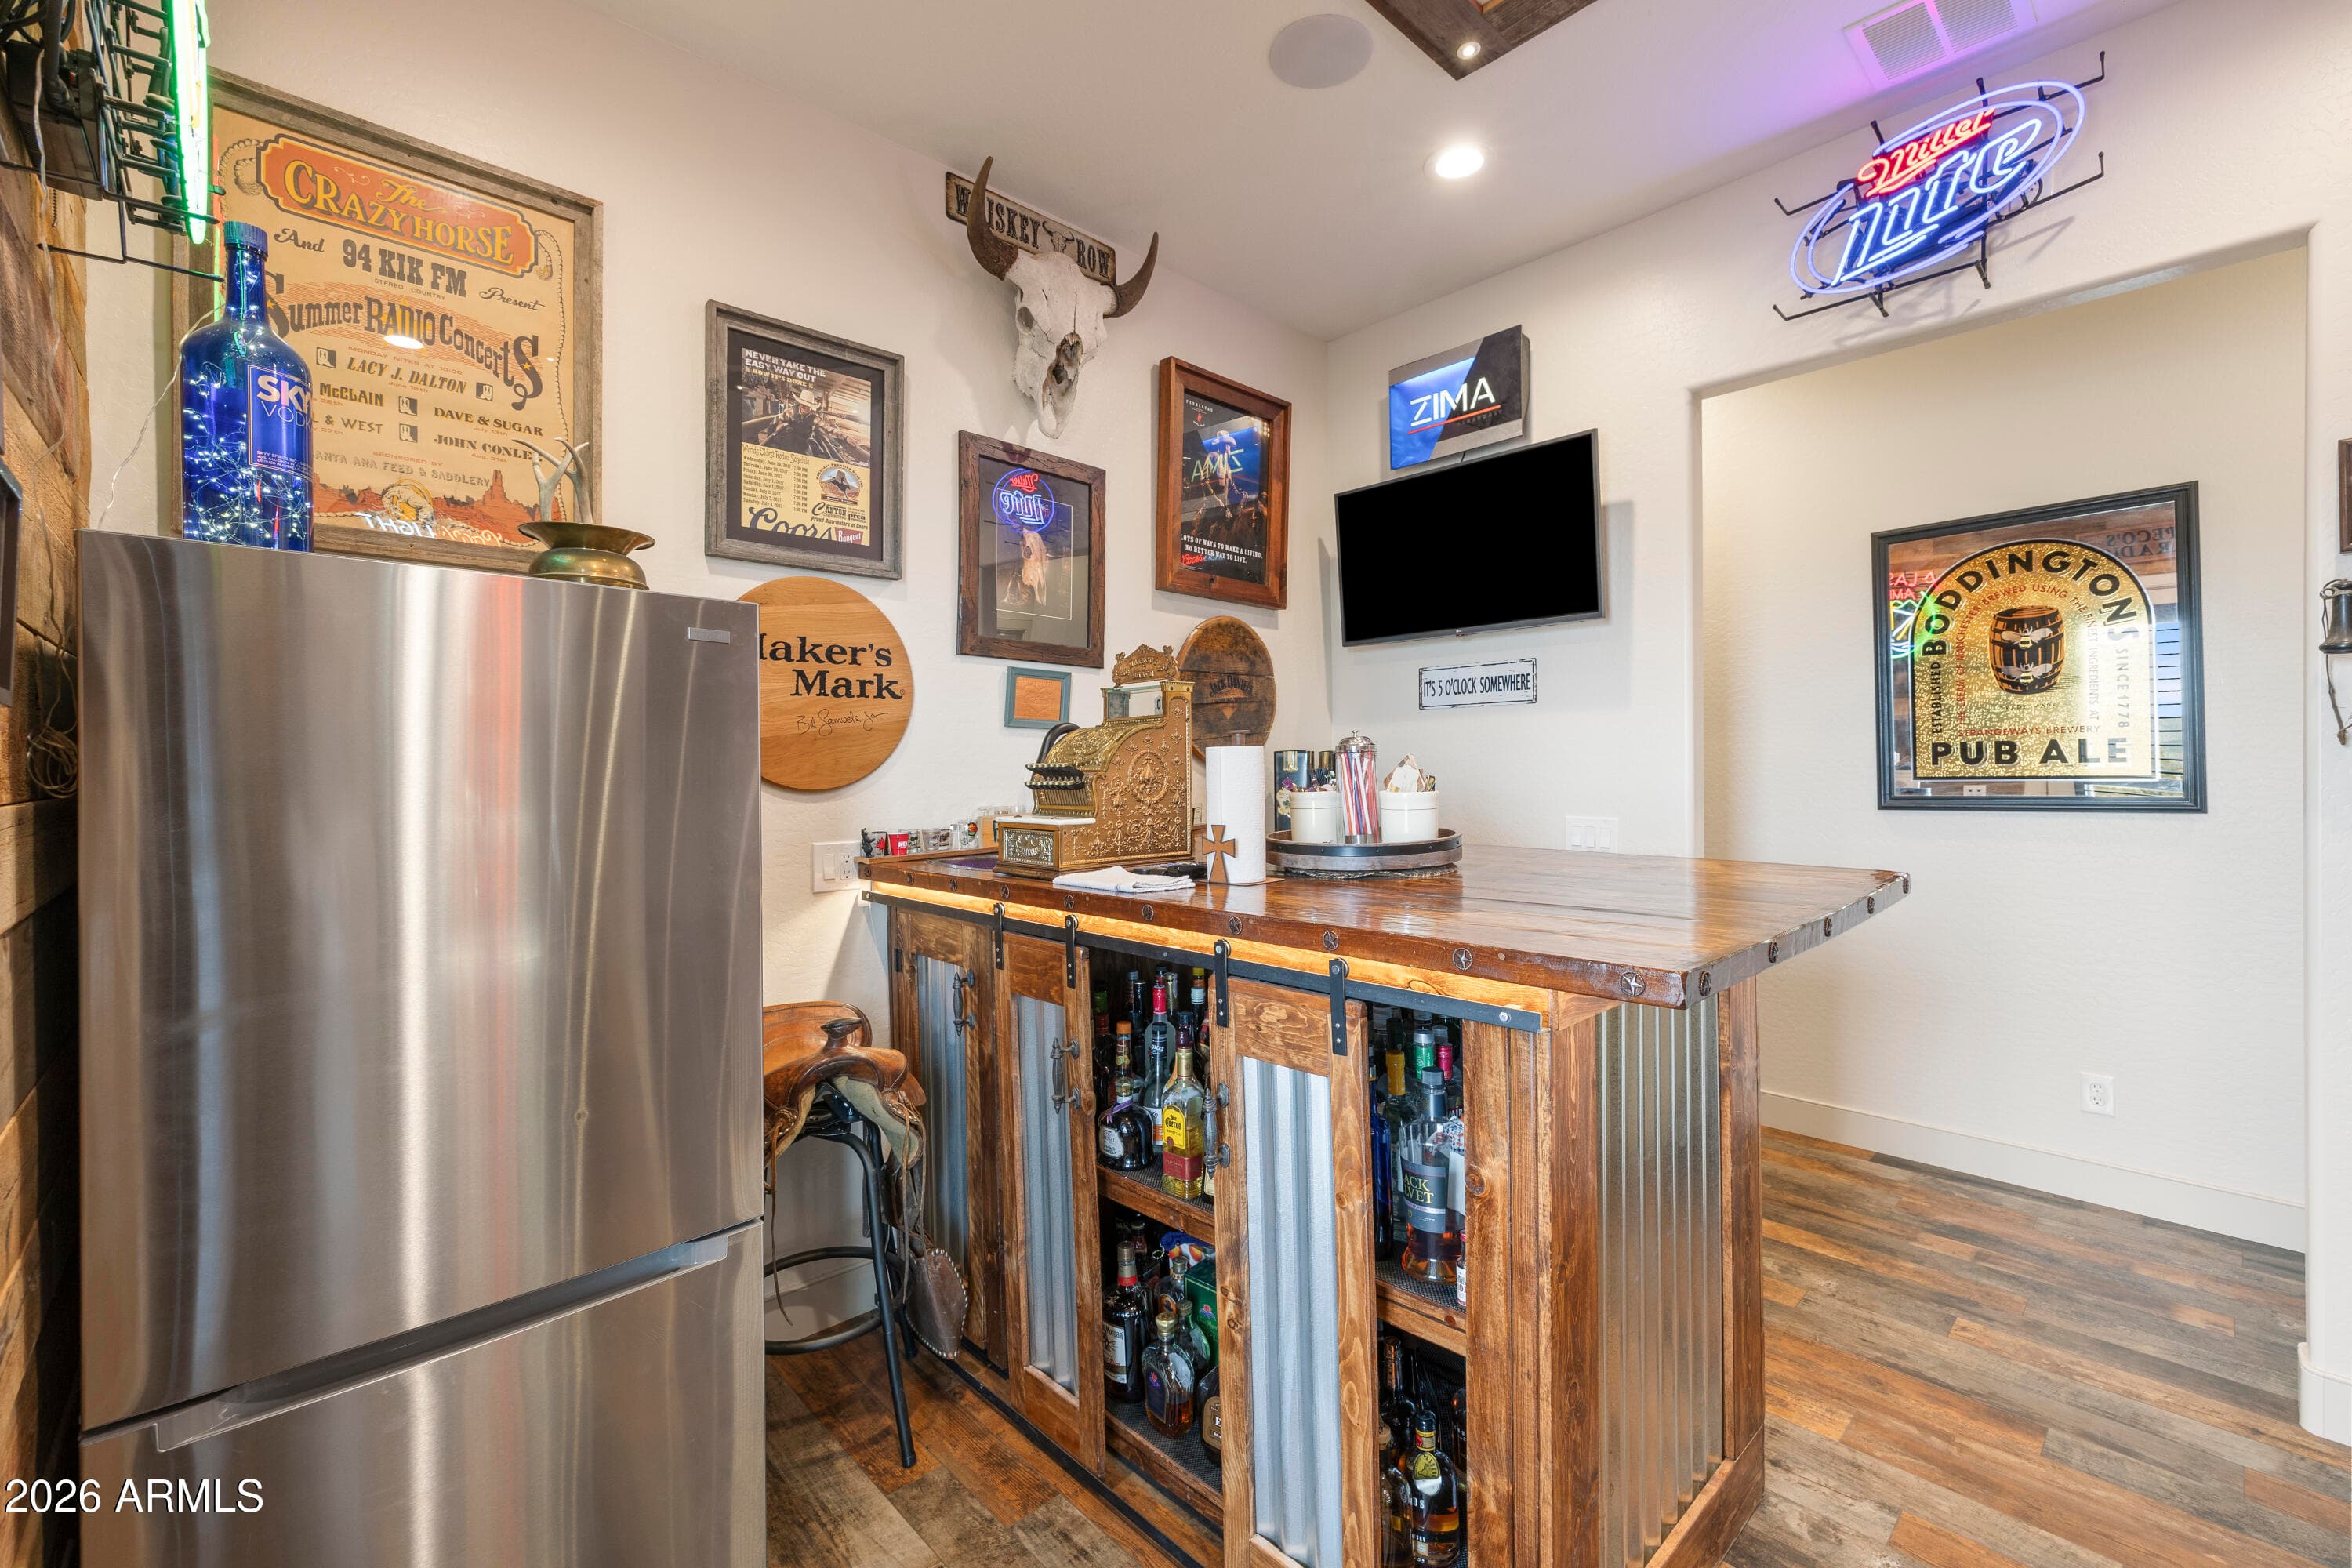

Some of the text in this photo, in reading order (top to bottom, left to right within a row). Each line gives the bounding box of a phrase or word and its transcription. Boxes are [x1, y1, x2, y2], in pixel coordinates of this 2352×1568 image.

[1856, 107, 1996, 198] Miller
[376, 179, 447, 214] The
[1831, 118, 2042, 287] Lite
[283, 159, 514, 264] CRAZY HORSE
[274, 228, 325, 253] And
[954, 182, 1110, 278] WISKEY ROW
[343, 238, 467, 297] 94 KIK FM
[374, 278, 446, 301] STEREO COUNTRY
[479, 286, 546, 311] Present
[365, 296, 436, 346] RADIO
[348, 346, 389, 359] MONDAY
[393, 355, 420, 367] NITES
[745, 349, 826, 377] NEVER TAKE THE
[346, 357, 468, 394] LACY J. DALTON
[745, 358, 817, 383] EASY WAY OUT
[752, 368, 771, 377] HOW
[786, 378, 808, 387] DONE
[319, 381, 384, 408] McCLAIN
[387, 380, 408, 390] June
[261, 401, 312, 430] VODK
[1410, 376, 1496, 428] ZIMA
[325, 414, 336, 426] &
[340, 416, 383, 435] WEST
[434, 406, 544, 437] DAVE & SUGAR
[372, 450, 428, 466] SPONSORED
[434, 434, 543, 463] JOHN CONLE
[313, 450, 490, 488] ANTA ANA FEED & SADDLERY
[848, 513, 866, 521] prca
[838, 530, 862, 545] Banquet
[1180, 533, 1194, 543] LOTS
[1203, 539, 1217, 548] WAYS
[1225, 544, 1240, 554] MAKE
[1244, 549, 1263, 559] LIVING.
[1194, 546, 1214, 556] BETTER
[1922, 549, 2139, 656] BODDINGTONS
[1982, 584, 2027, 605] BREWED
[2031, 584, 2069, 599] USING
[2069, 597, 2089, 613] THE
[1956, 606, 1982, 662] MANCHESTER
[2082, 612, 2099, 642] FINEST
[759, 633, 893, 667] aker's
[790, 669, 903, 700] Mark
[1210, 677, 1226, 698] JACK
[1423, 673, 1531, 697] IT'S 5 O'CLOCK SOMEWHERE
[2088, 648, 2100, 705] INGREDIENTS
[2116, 648, 2130, 728] SINCE 1778
[1931, 661, 1943, 734] ESTABLISHED
[2089, 709, 2100, 720] AT
[1958, 724, 2100, 738] STRANGEWAYS BREWERY
[1931, 737, 2132, 767] PUB ALE
[1165, 1117, 1182, 1131] Cuervo
[1404, 1173, 1430, 1192] ACK
[1404, 1184, 1435, 1203] LVET
